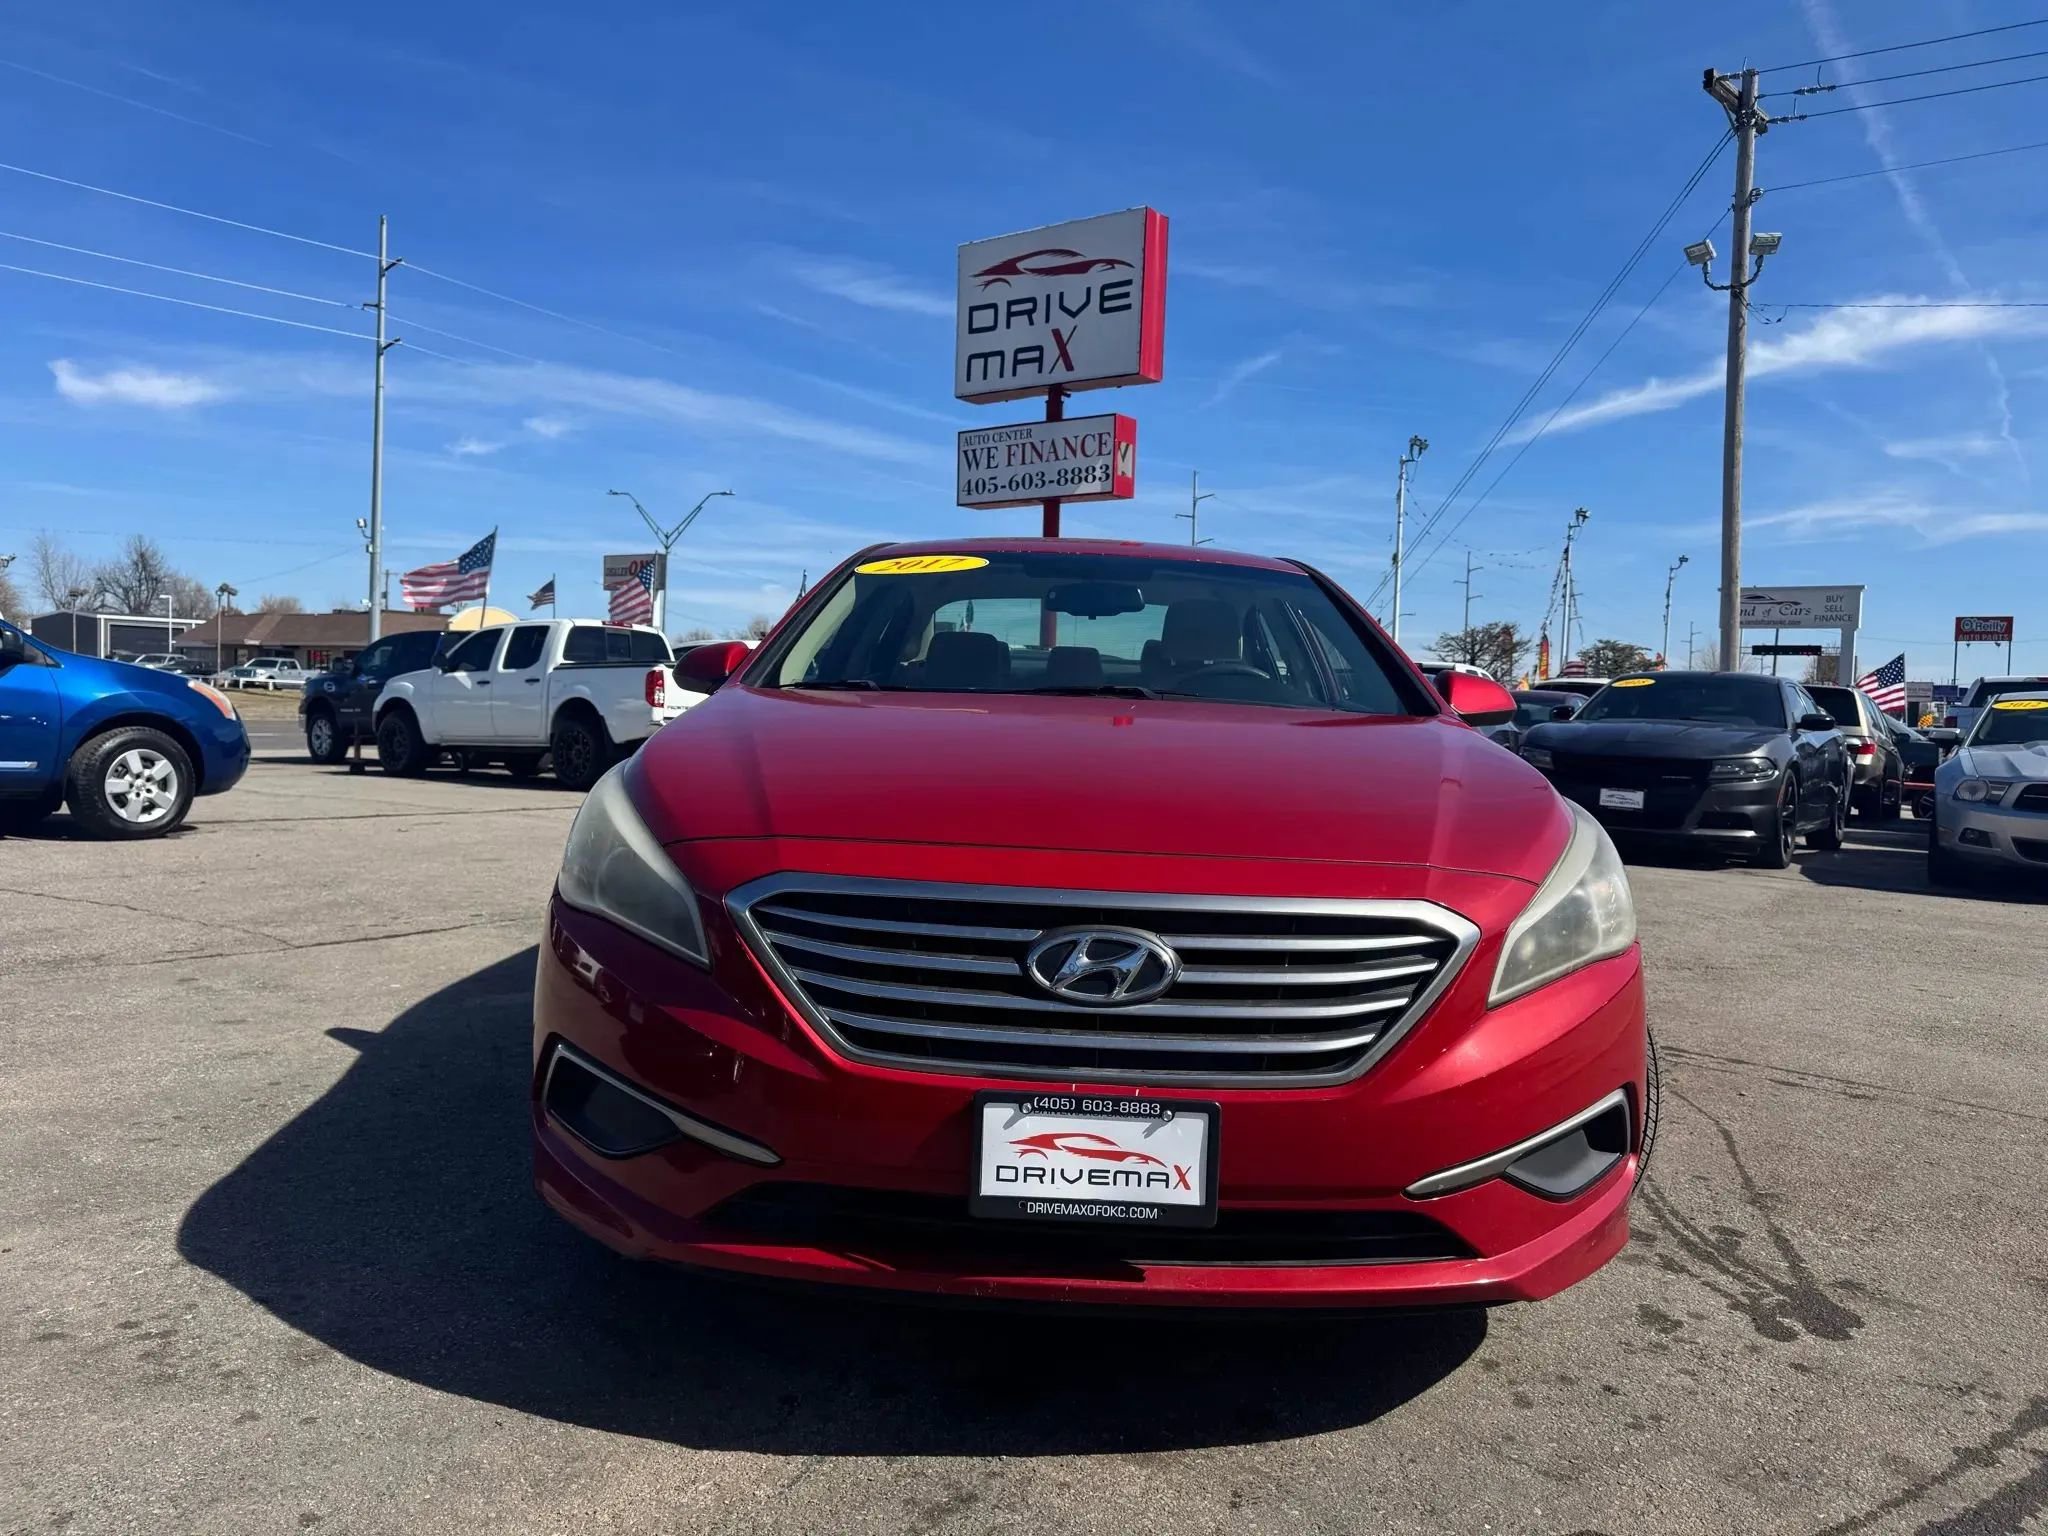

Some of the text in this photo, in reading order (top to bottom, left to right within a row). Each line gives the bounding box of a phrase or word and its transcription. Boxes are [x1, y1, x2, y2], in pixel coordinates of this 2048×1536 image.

[968, 278, 1133, 335] DRIVE
[966, 324, 1078, 382] MAX
[963, 428, 1033, 447] AUTO CENTER
[963, 432, 1112, 472] WE FINANCE
[962, 463, 1111, 496] 405-603-8883
[873, 558, 967, 572] 2017
[1825, 595, 1844, 603] BUY
[1740, 606, 1756, 617] nd
[1779, 604, 1811, 616] Cars
[1814, 614, 1853, 622] FINANCE
[1824, 605, 1844, 613] SELL
[1033, 1096, 1076, 1110] (405)
[1082, 1099, 1160, 1115] 603-8883
[995, 1164, 1192, 1191] DRIVEMAX
[1026, 1201, 1158, 1219] DRIVEMAXOFOKC.COM
